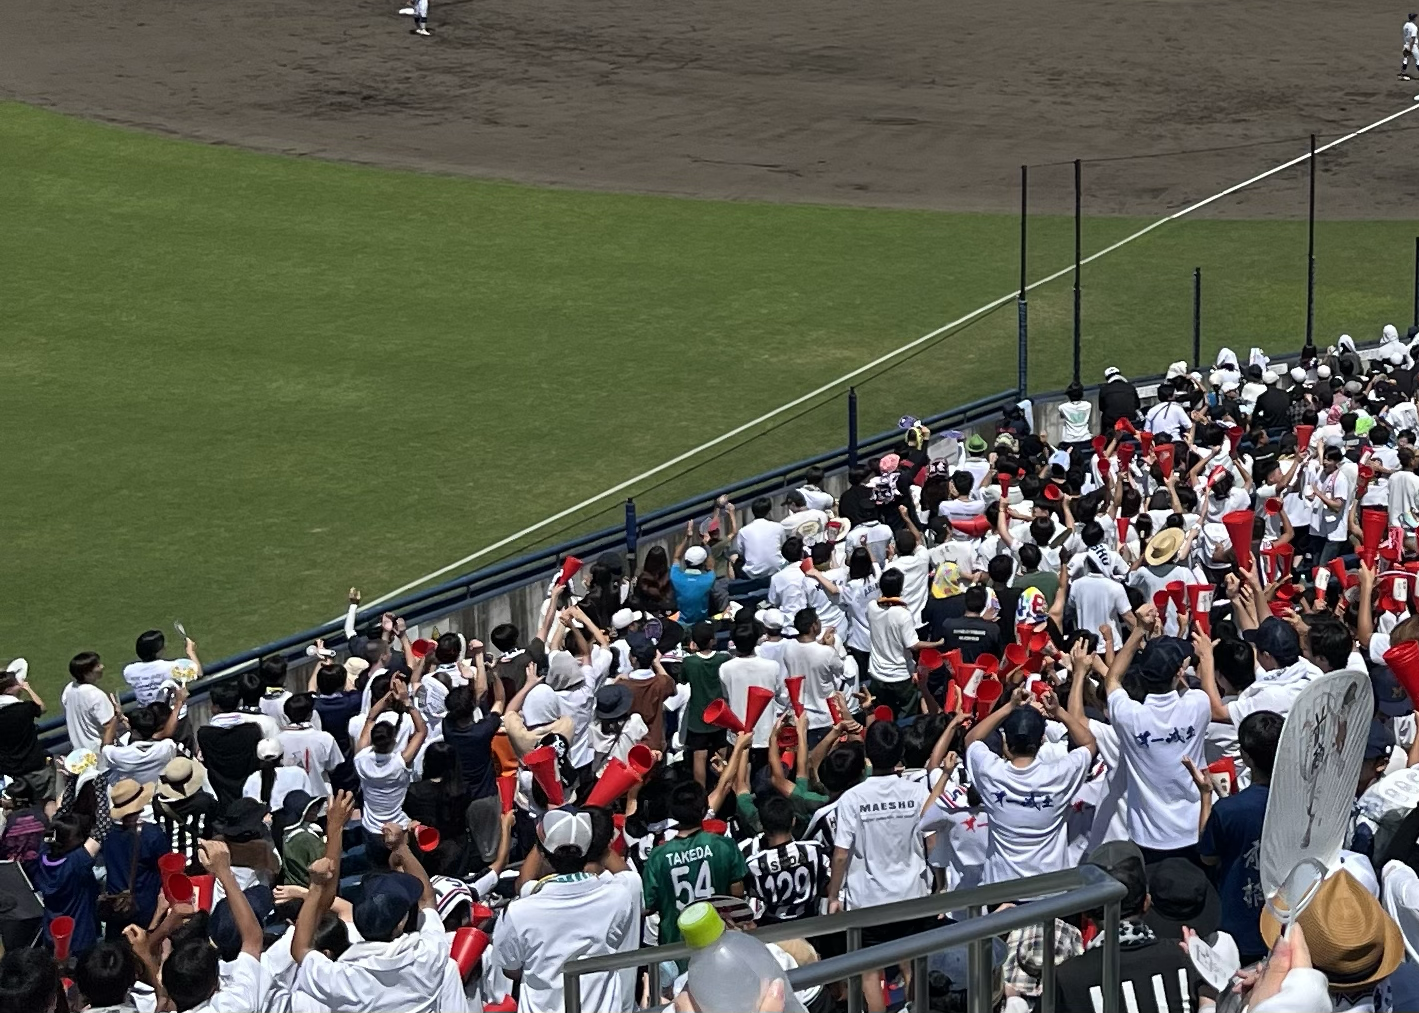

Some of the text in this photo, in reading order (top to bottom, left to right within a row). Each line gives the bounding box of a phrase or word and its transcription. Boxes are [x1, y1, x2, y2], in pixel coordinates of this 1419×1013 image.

[859, 800, 915, 813] MAESHO
[665, 844, 713, 866] TAKEDA
[671, 860, 715, 911] 54
[764, 865, 811, 906] 129
